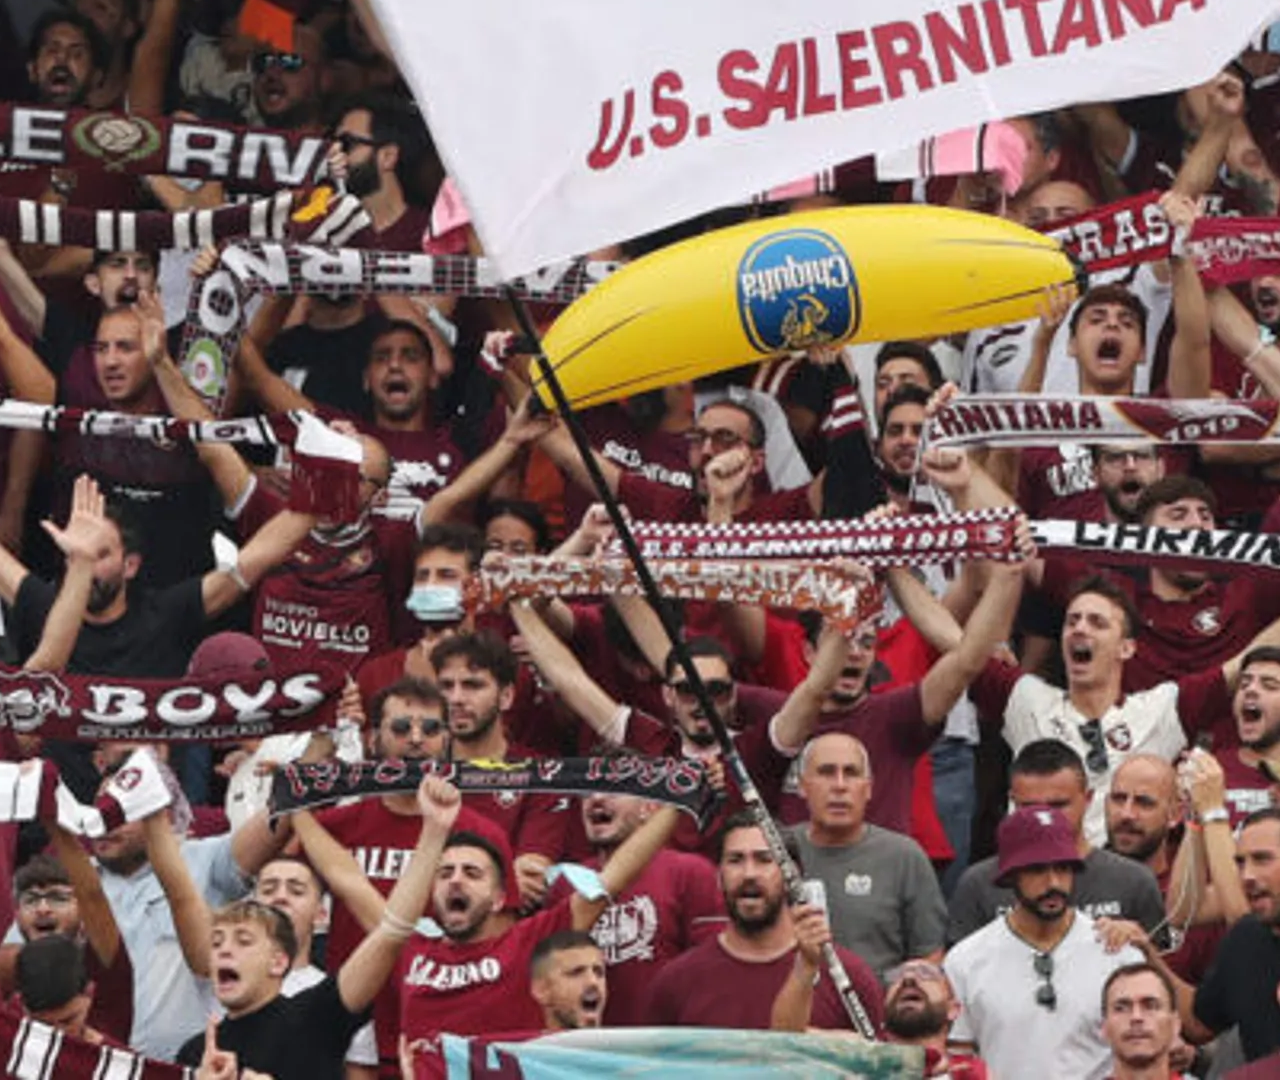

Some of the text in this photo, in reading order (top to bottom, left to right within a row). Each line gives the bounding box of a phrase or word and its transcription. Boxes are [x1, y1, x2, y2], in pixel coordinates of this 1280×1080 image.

[587, 69, 712, 170] U.S.
[741, 253, 850, 303] Chiquita
[81, 673, 325, 726] BOYS
